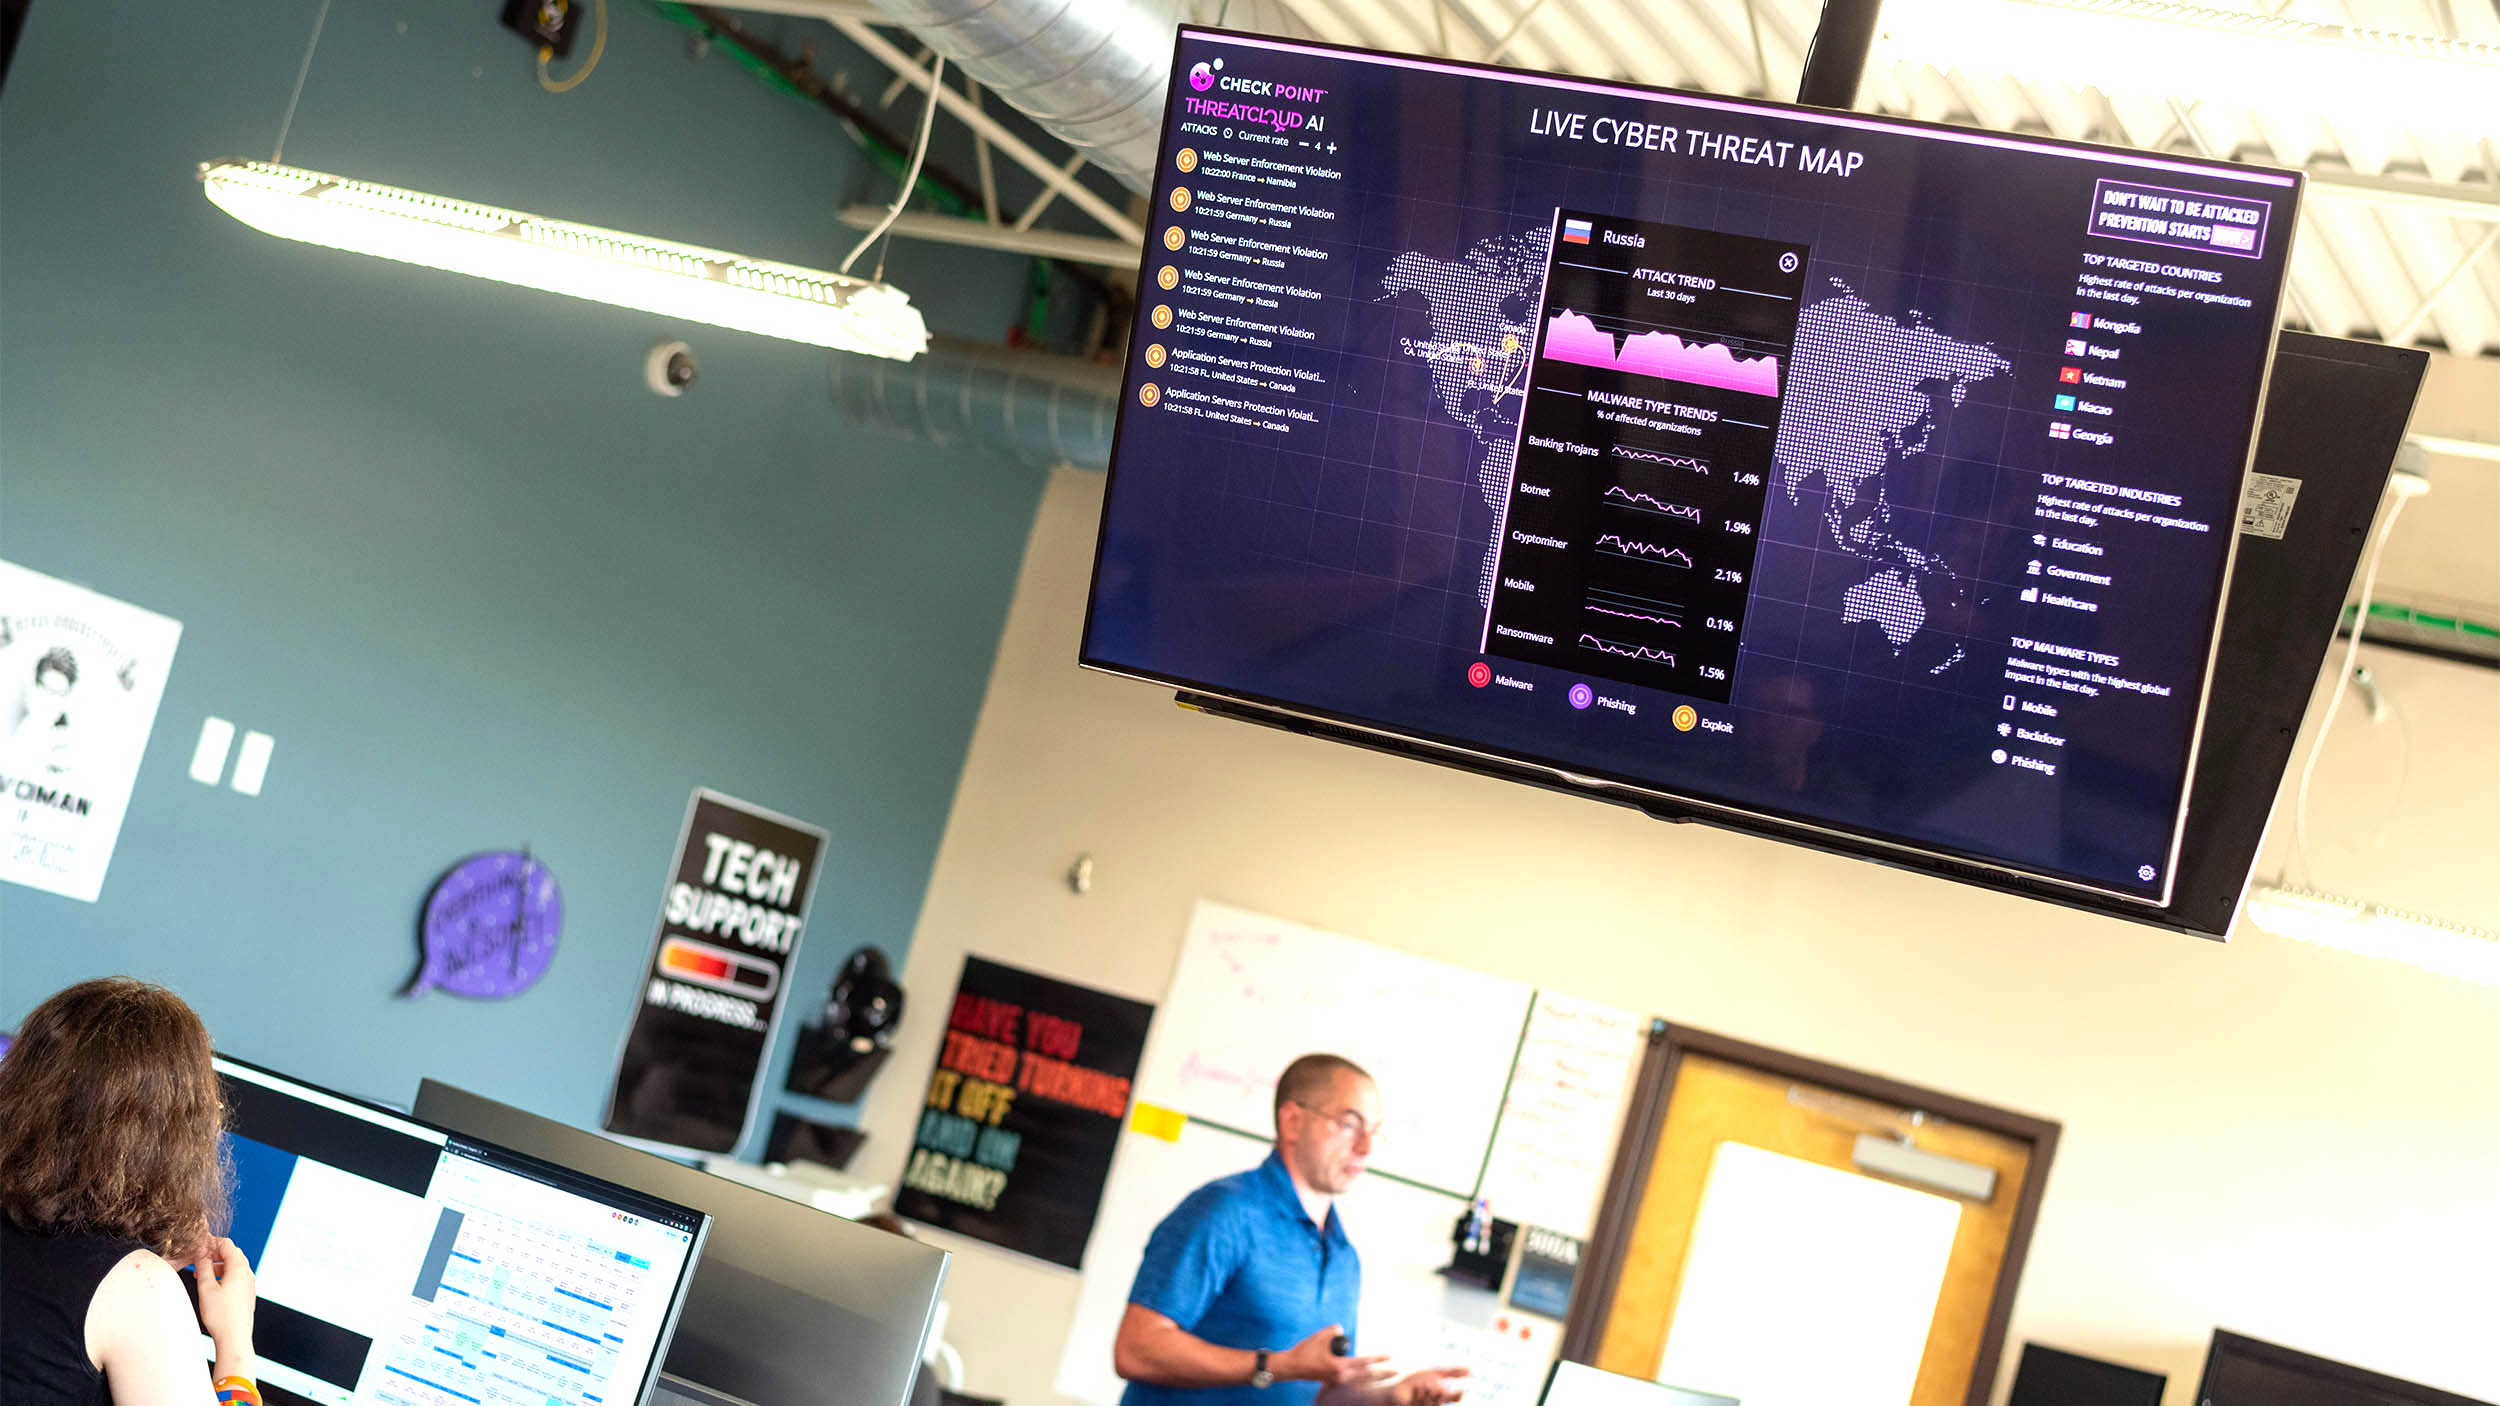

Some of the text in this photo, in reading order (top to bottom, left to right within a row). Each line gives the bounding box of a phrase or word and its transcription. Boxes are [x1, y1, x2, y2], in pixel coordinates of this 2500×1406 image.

[1220, 76, 1273, 96] CHECK
[1180, 122, 1218, 136] ATTACKS
[1305, 114, 1324, 132] AI
[1238, 130, 1289, 146] Current rate
[1314, 141, 1321, 151] 4
[1530, 108, 1864, 177] LIVE CYBER THREAT MAP
[1203, 150, 1342, 180] Web Server Enforcement Violation
[1201, 166, 1297, 189] 10:22:00 France Namibia
[1196, 189, 1335, 220] Web Server Enforcement Violation
[2103, 189, 2260, 225] DON'T WAIT TO BE ATTACKED
[1194, 206, 1292, 229] 10:21:59 Germany Russia
[2098, 211, 2169, 235] PREVENTION
[2168, 221, 2211, 241] STARTS
[1190, 229, 1328, 260] Web Server Enforcement Violation
[1603, 229, 1645, 248] Russia
[1188, 245, 1285, 269] 10:21:59 Germany Russia
[2082, 253, 2222, 283] TOP TARGETED COUNTRIES
[1184, 268, 1322, 300] Web Server Enforcement Violation
[1632, 267, 1716, 290] ATTACK TREND
[1646, 287, 1696, 304] Last 30 days
[2076, 286, 2086, 296] in
[2086, 288, 2103, 299] the
[2102, 290, 2121, 302] last
[2078, 273, 2252, 308] Highest rate of attacks per organization
[1178, 307, 1315, 340] Web Server Enforcement Violation
[2093, 317, 2141, 334] Mongolia
[1176, 323, 1272, 348] 10:21:59 Germany Russia
[1171, 347, 1217, 364] Application
[1217, 355, 1249, 369] Servers
[1249, 360, 1292, 377] Protection
[2088, 345, 2120, 359] Nepal
[2082, 372, 2126, 389] Vietnam
[1164, 386, 1211, 403] Application
[1211, 394, 1243, 409] Servers
[1242, 400, 1286, 417] Protection
[1587, 389, 1718, 422] MALWARE TYPE TRENDS
[2077, 400, 2113, 416] Macao
[1596, 409, 1702, 436] % of affected organizations
[1528, 435, 1599, 457] Banking Trojans
[2072, 428, 2113, 445] Georgia
[1520, 482, 1551, 497] Botnet
[1733, 471, 1760, 486] 1.4%
[2041, 473, 2182, 507] TOP TARGETED INDUSTRIES
[2034, 506, 2045, 517] in
[2045, 508, 2061, 520] the
[2061, 511, 2079, 523] last
[2037, 494, 2209, 532] Highest rate of attacks per organization
[1724, 520, 1751, 535] 1.9%
[1512, 530, 1568, 549] Cryptominer
[2051, 537, 2103, 556] Education
[1504, 577, 1535, 592] Mobile
[1714, 568, 1742, 583] 2.1%
[2046, 565, 2111, 586] Government
[2041, 592, 2098, 612] Healthcare
[1496, 624, 1554, 645] Ransomware
[1706, 616, 1734, 632] 0.1%
[2010, 636, 2119, 667] TOP MALWARE TYPES
[1495, 674, 1533, 691] Malware
[1699, 665, 1725, 680] 1.5%
[2004, 669, 2036, 684] impact
[2035, 675, 2045, 685] in
[2045, 677, 2062, 689] the
[2061, 680, 2080, 692] last
[2006, 656, 2171, 696] Malware types with the highest global
[1597, 695, 1636, 715] Phishing
[2021, 701, 2057, 717] Mobile
[1701, 717, 1734, 734] Exploit
[2016, 727, 2066, 746] Backdoor
[2011, 755, 2056, 776] Phishing
[703, 832, 801, 907] TECH
[665, 882, 802, 954] SUPPORT
[648, 977, 671, 1005] IN
[951, 992, 1082, 1060] HAVE YOU
[941, 1029, 1018, 1084] TRIED
[1018, 1050, 1131, 1118] TURNING
[926, 1068, 1017, 1125] IT OFF
[917, 1109, 1021, 1173] AND ON
[904, 1149, 1007, 1211] AGAIN?
